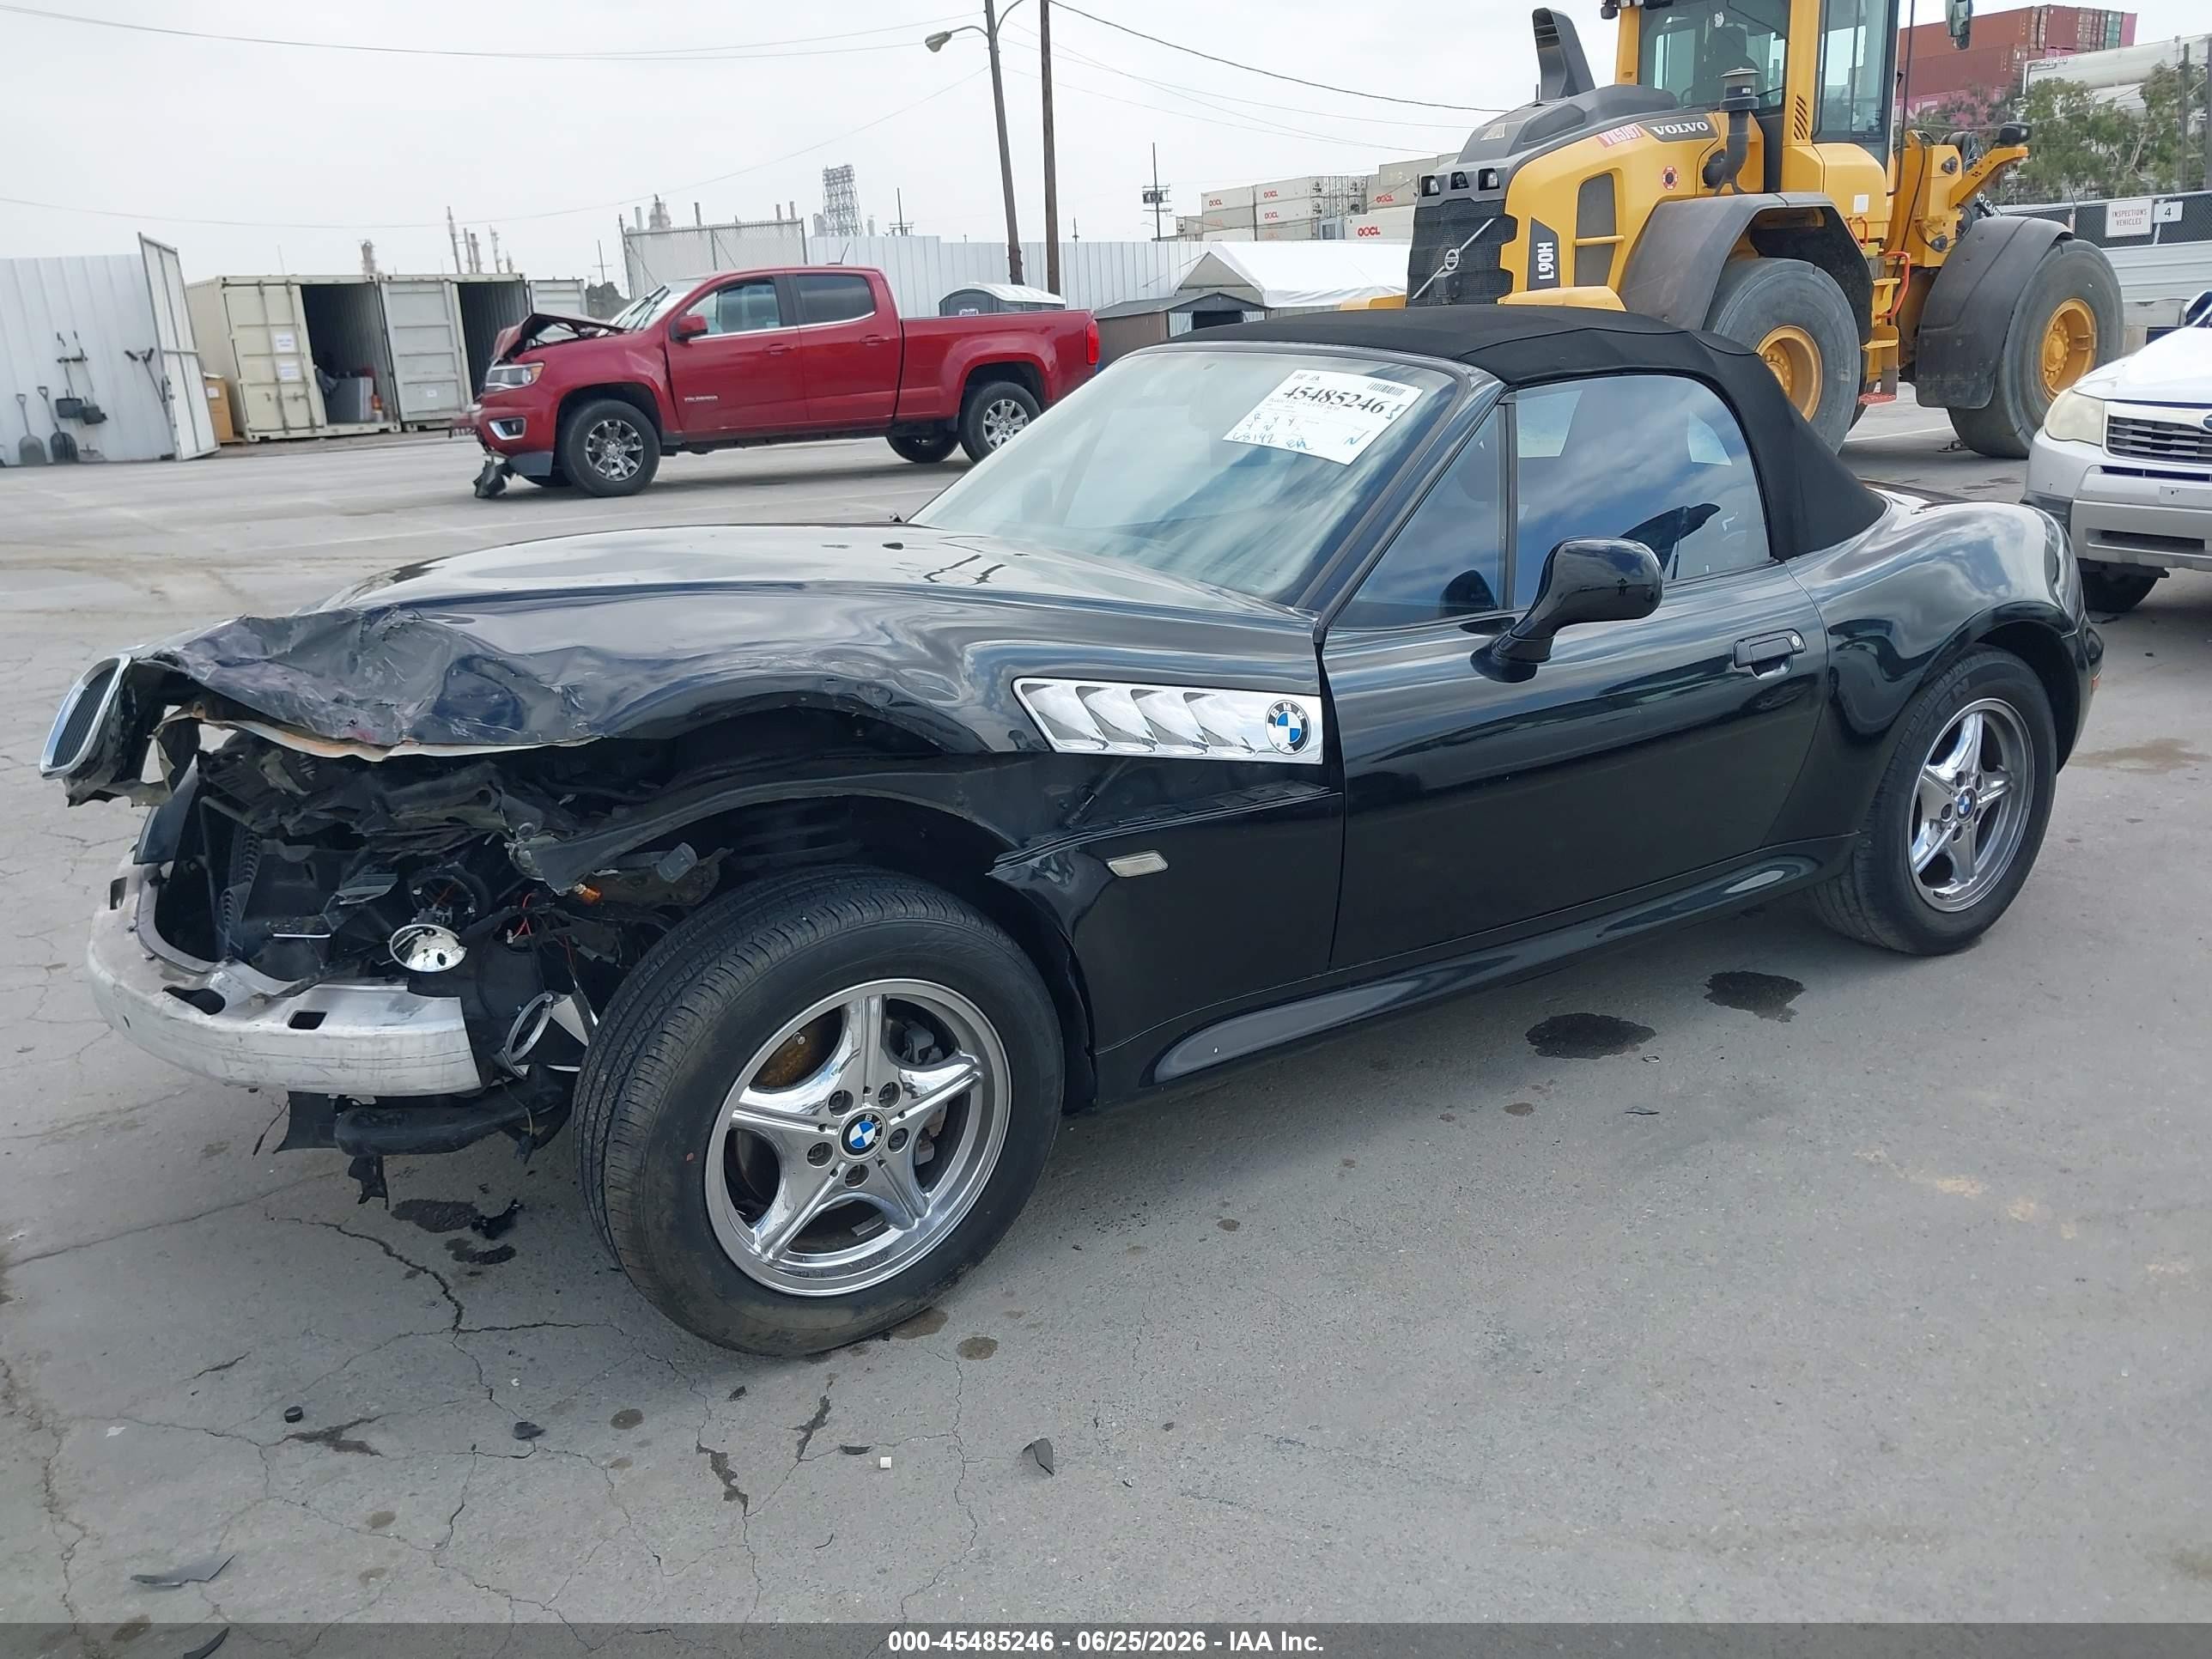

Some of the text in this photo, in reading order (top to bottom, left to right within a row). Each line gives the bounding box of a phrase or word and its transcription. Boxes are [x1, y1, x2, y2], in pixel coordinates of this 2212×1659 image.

[1650, 121, 1710, 136] VOLVO
[1264, 191, 1278, 199] OOCL
[1209, 198, 1223, 207] OOCL
[2112, 209, 2148, 218] INSPECTIONS
[2164, 207, 2172, 217] 4
[2116, 218, 2142, 227] VEHICLES
[1358, 226, 1381, 237] OOCL
[1537, 241, 1554, 281] L90H
[1283, 386, 1392, 414] 45485246
[1270, 702, 1305, 720] BMW
[865, 1114, 882, 1144] BMW
